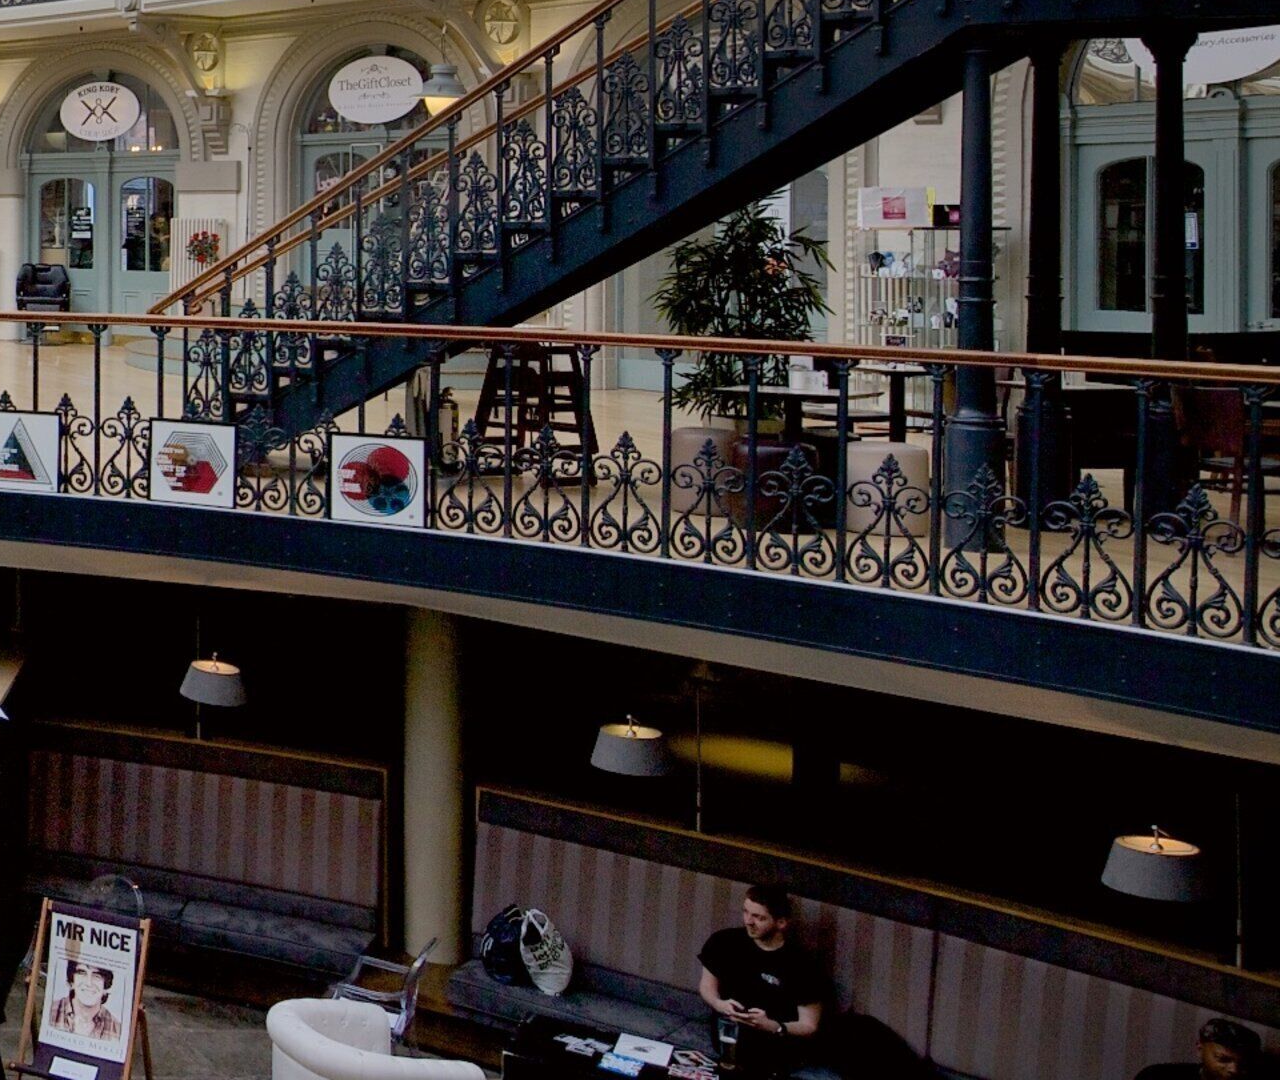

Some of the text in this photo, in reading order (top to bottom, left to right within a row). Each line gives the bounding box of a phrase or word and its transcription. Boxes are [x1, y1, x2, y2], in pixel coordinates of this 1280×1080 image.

[77, 84, 121, 98] KING KOBY
[337, 75, 412, 92] TheGiftCloset
[55, 919, 132, 953] MR NICE
